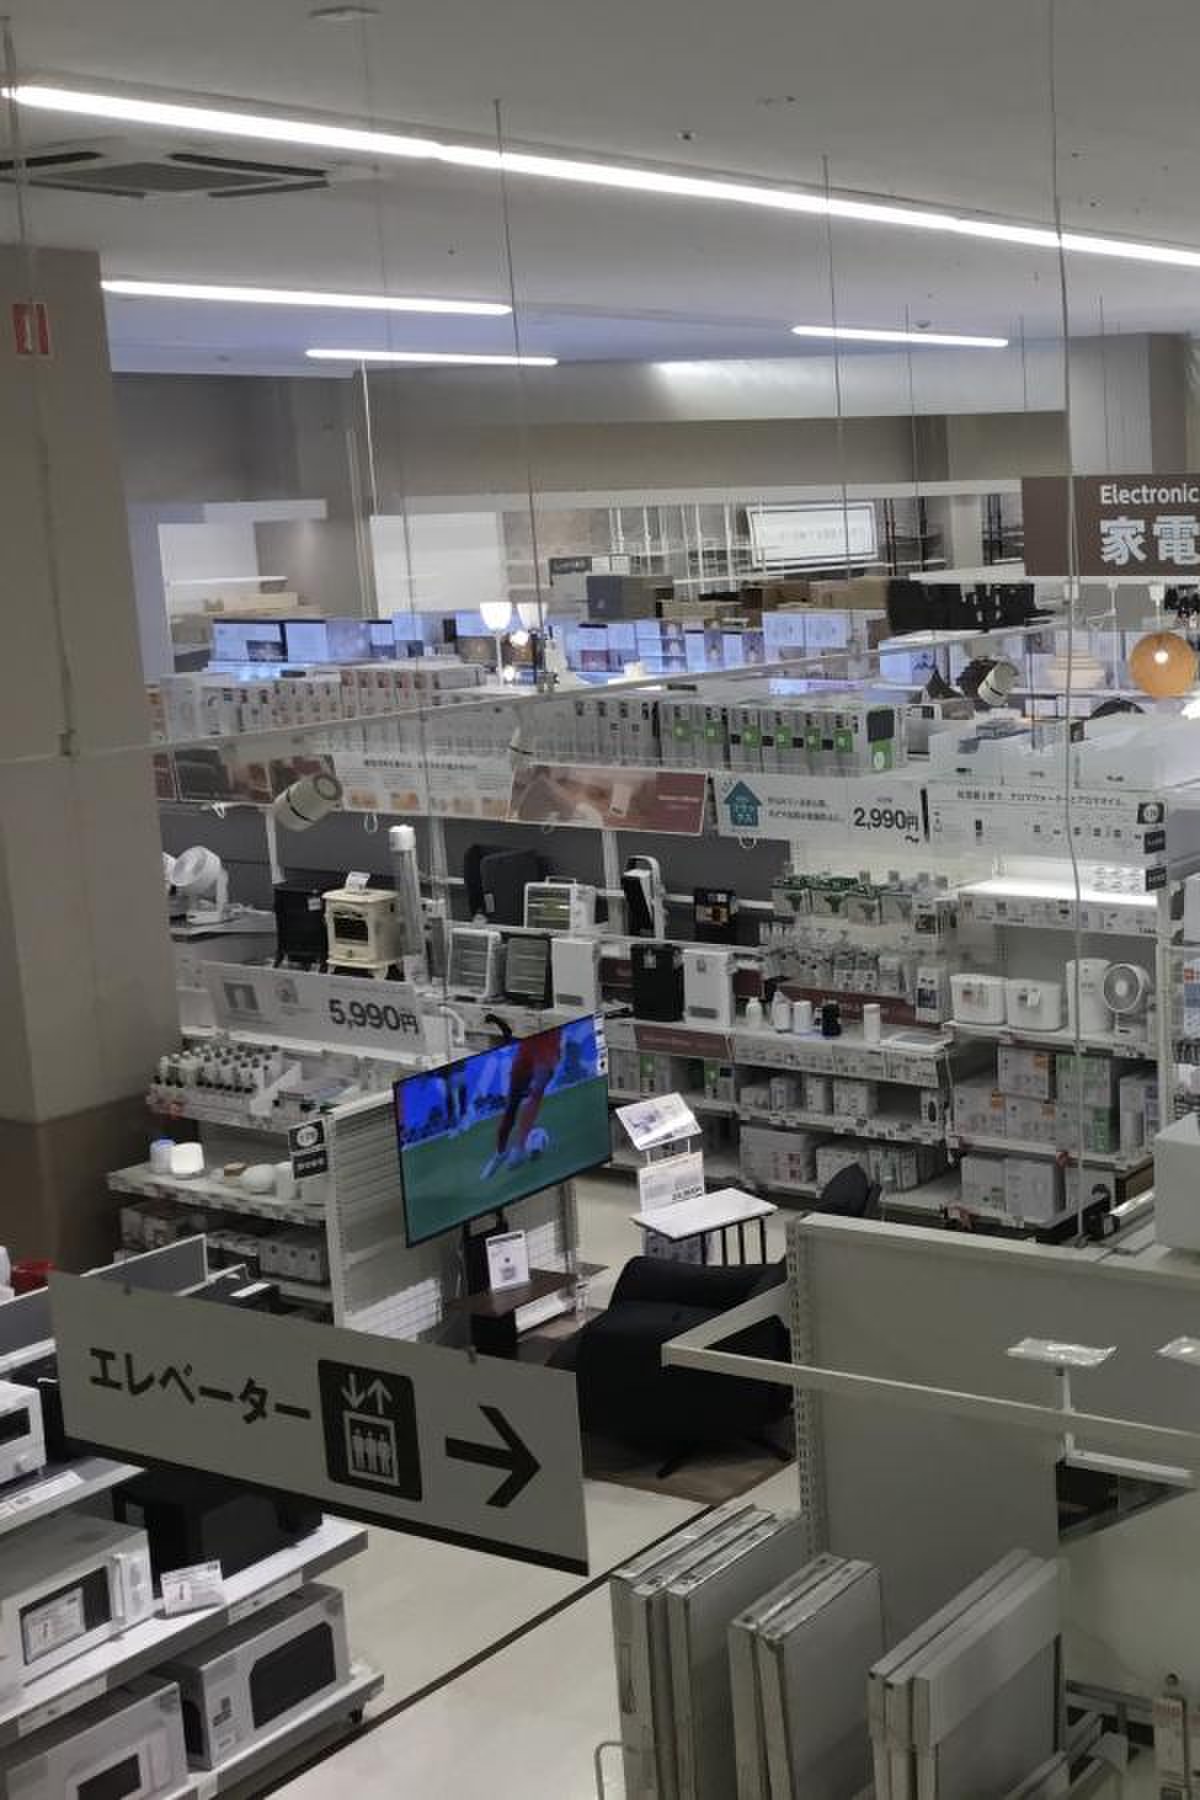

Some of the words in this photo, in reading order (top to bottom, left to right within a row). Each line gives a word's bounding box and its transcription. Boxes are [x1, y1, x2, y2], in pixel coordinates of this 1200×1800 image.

[853, 807, 920, 832] 2,990円
[328, 998, 419, 1035] 5,990円
[89, 1347, 312, 1424] エレベーター
